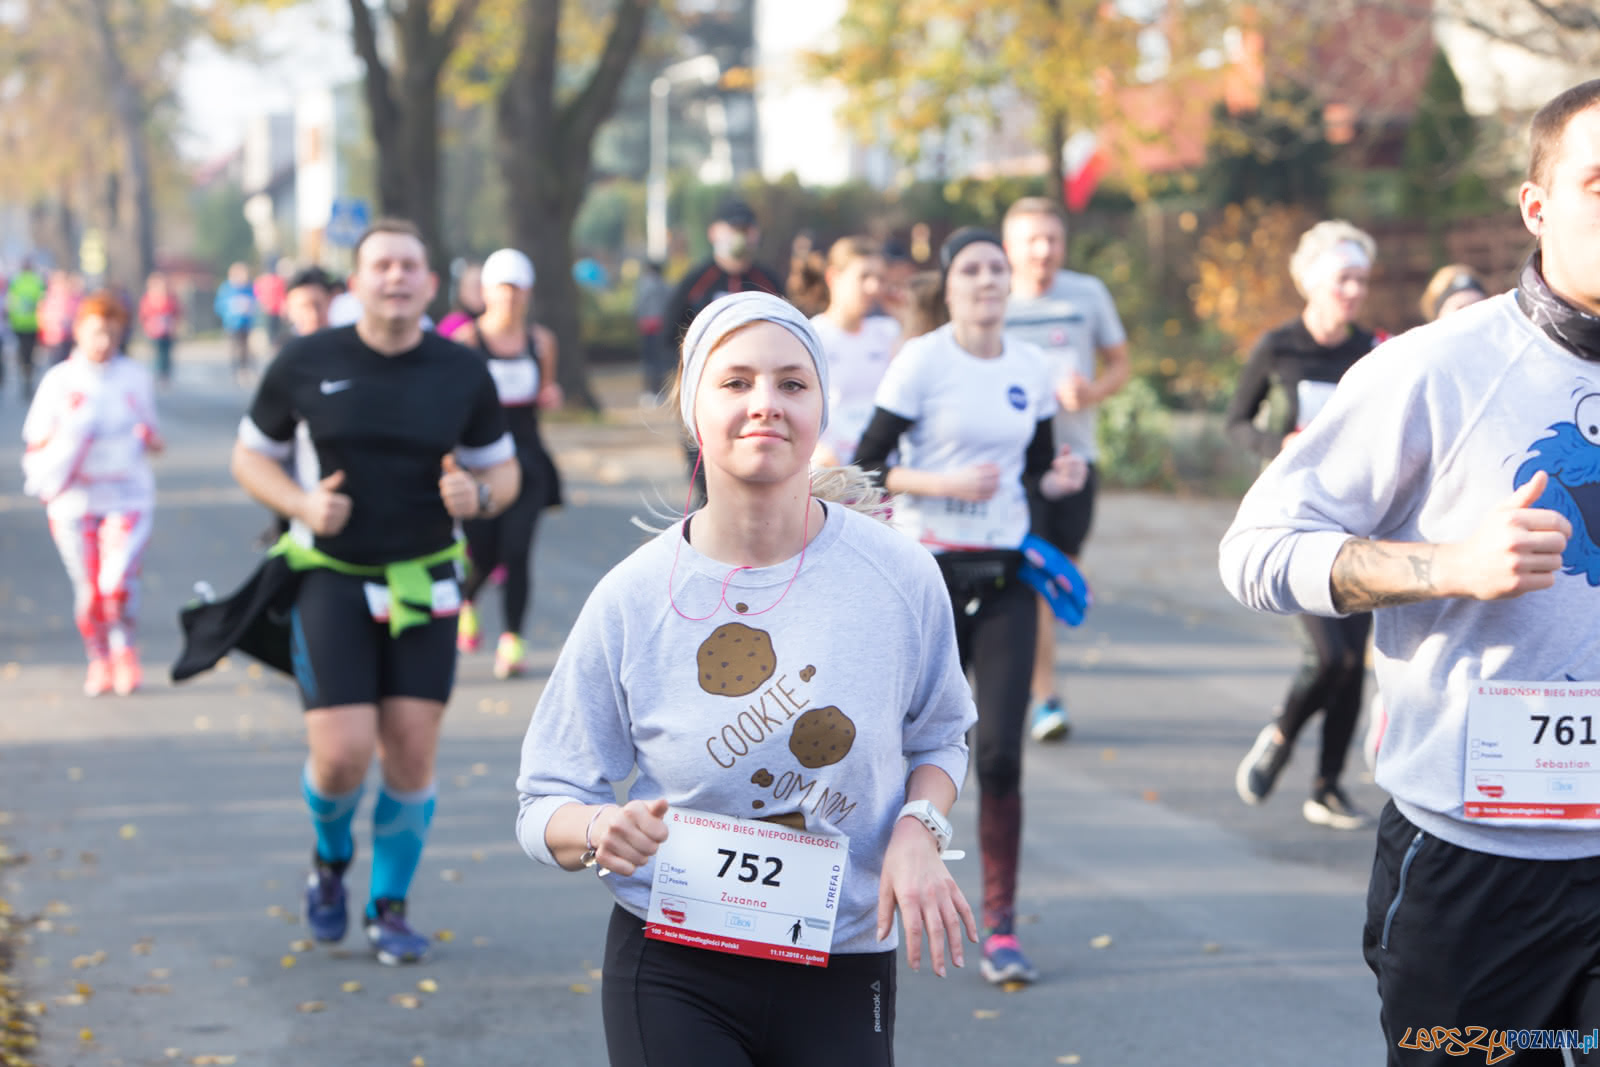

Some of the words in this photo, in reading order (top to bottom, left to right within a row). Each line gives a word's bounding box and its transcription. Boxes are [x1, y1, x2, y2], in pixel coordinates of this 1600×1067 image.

[1544, 688, 1566, 696] BIEG
[706, 674, 810, 768] COOKIE
[1530, 715, 1597, 746] 761
[1535, 758, 1590, 768] Sebastian
[774, 771, 817, 806] OM
[674, 814, 682, 823] 8.
[684, 816, 730, 832] LUBOŃSKI
[734, 824, 754, 836] BIEG
[758, 828, 839, 850] NIEPODLEGŁOŚCI
[716, 848, 783, 887] 752
[721, 892, 767, 908] Zuzanna
[826, 875, 839, 909] STREFA
[721, 940, 739, 950] Polski
